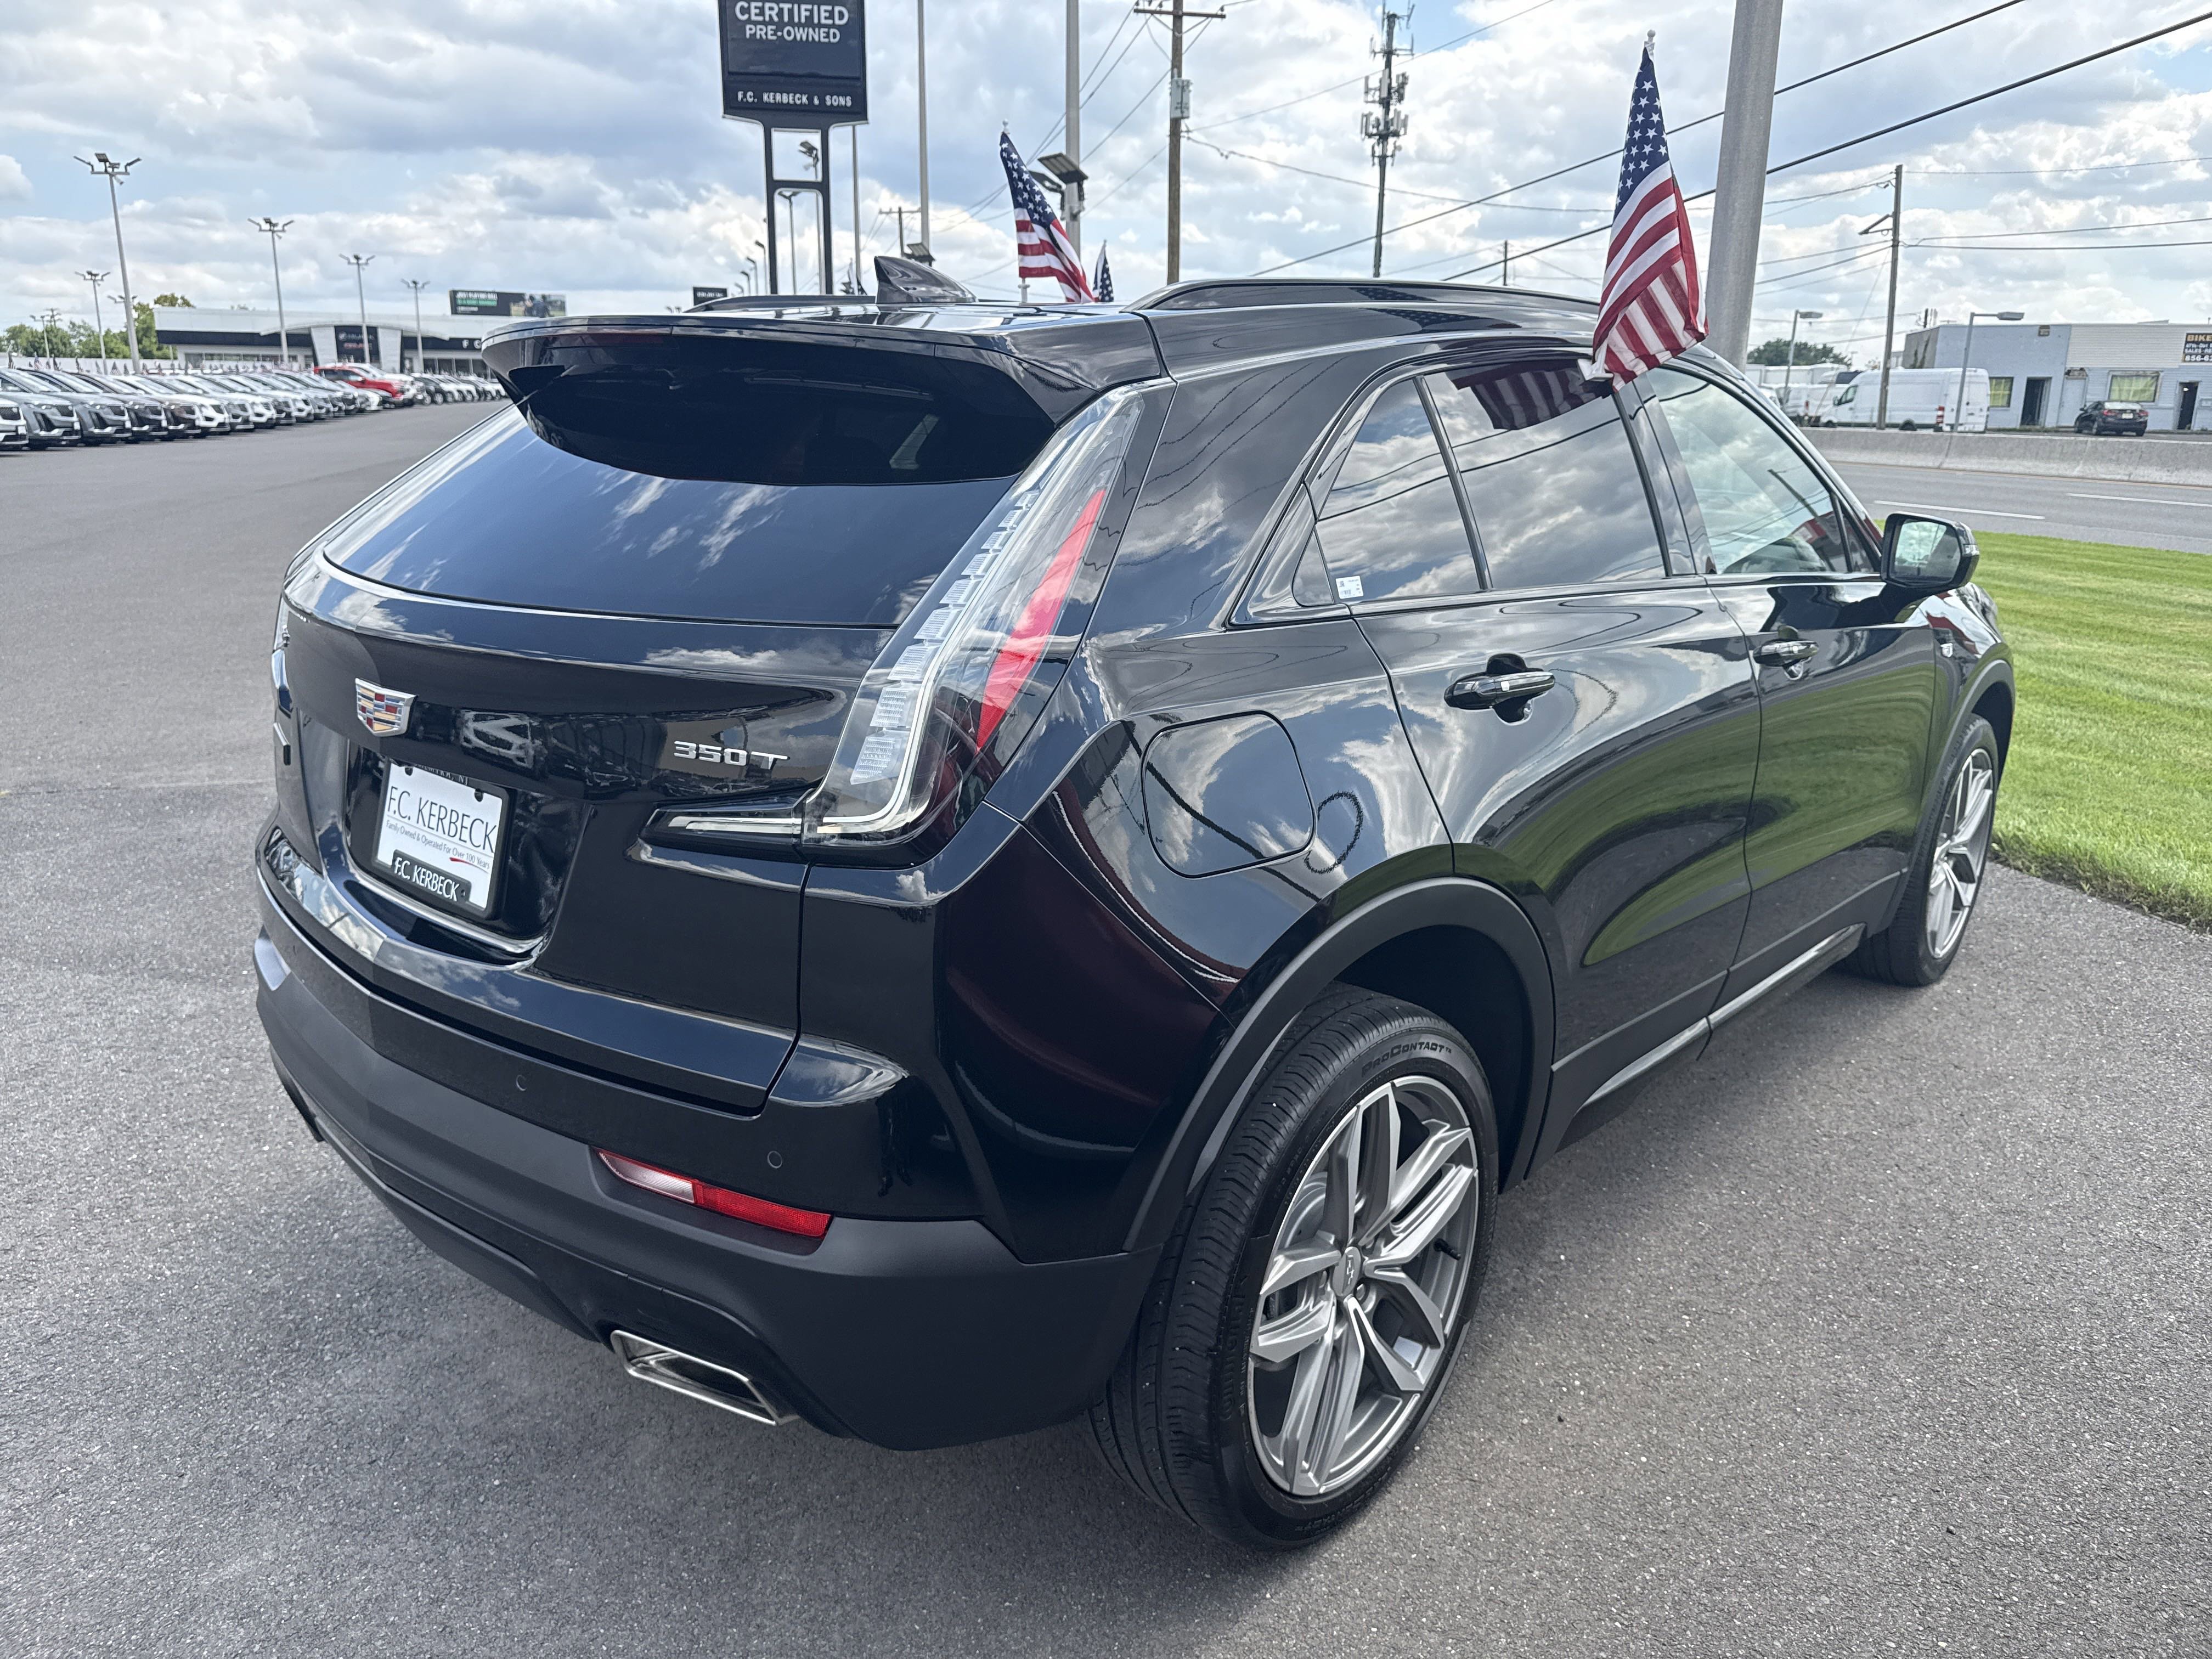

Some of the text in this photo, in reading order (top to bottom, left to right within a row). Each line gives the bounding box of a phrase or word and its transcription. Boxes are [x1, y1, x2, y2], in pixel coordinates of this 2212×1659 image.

[735, 1, 849, 25] CERTIFIED
[745, 25, 840, 43] PRE-OWNED
[737, 91, 852, 107] F.C. KERBECK & SONS
[673, 740, 789, 770] 350T
[387, 785, 497, 854] F.C. KERBECK
[386, 819, 400, 833] Family
[400, 825, 417, 840] Owned
[421, 834, 443, 851] Operated
[443, 843, 452, 854] For
[452, 847, 465, 859] Over
[466, 852, 476, 864] 100
[476, 857, 490, 870] Years
[393, 856, 460, 902] F.C. KERBECK
